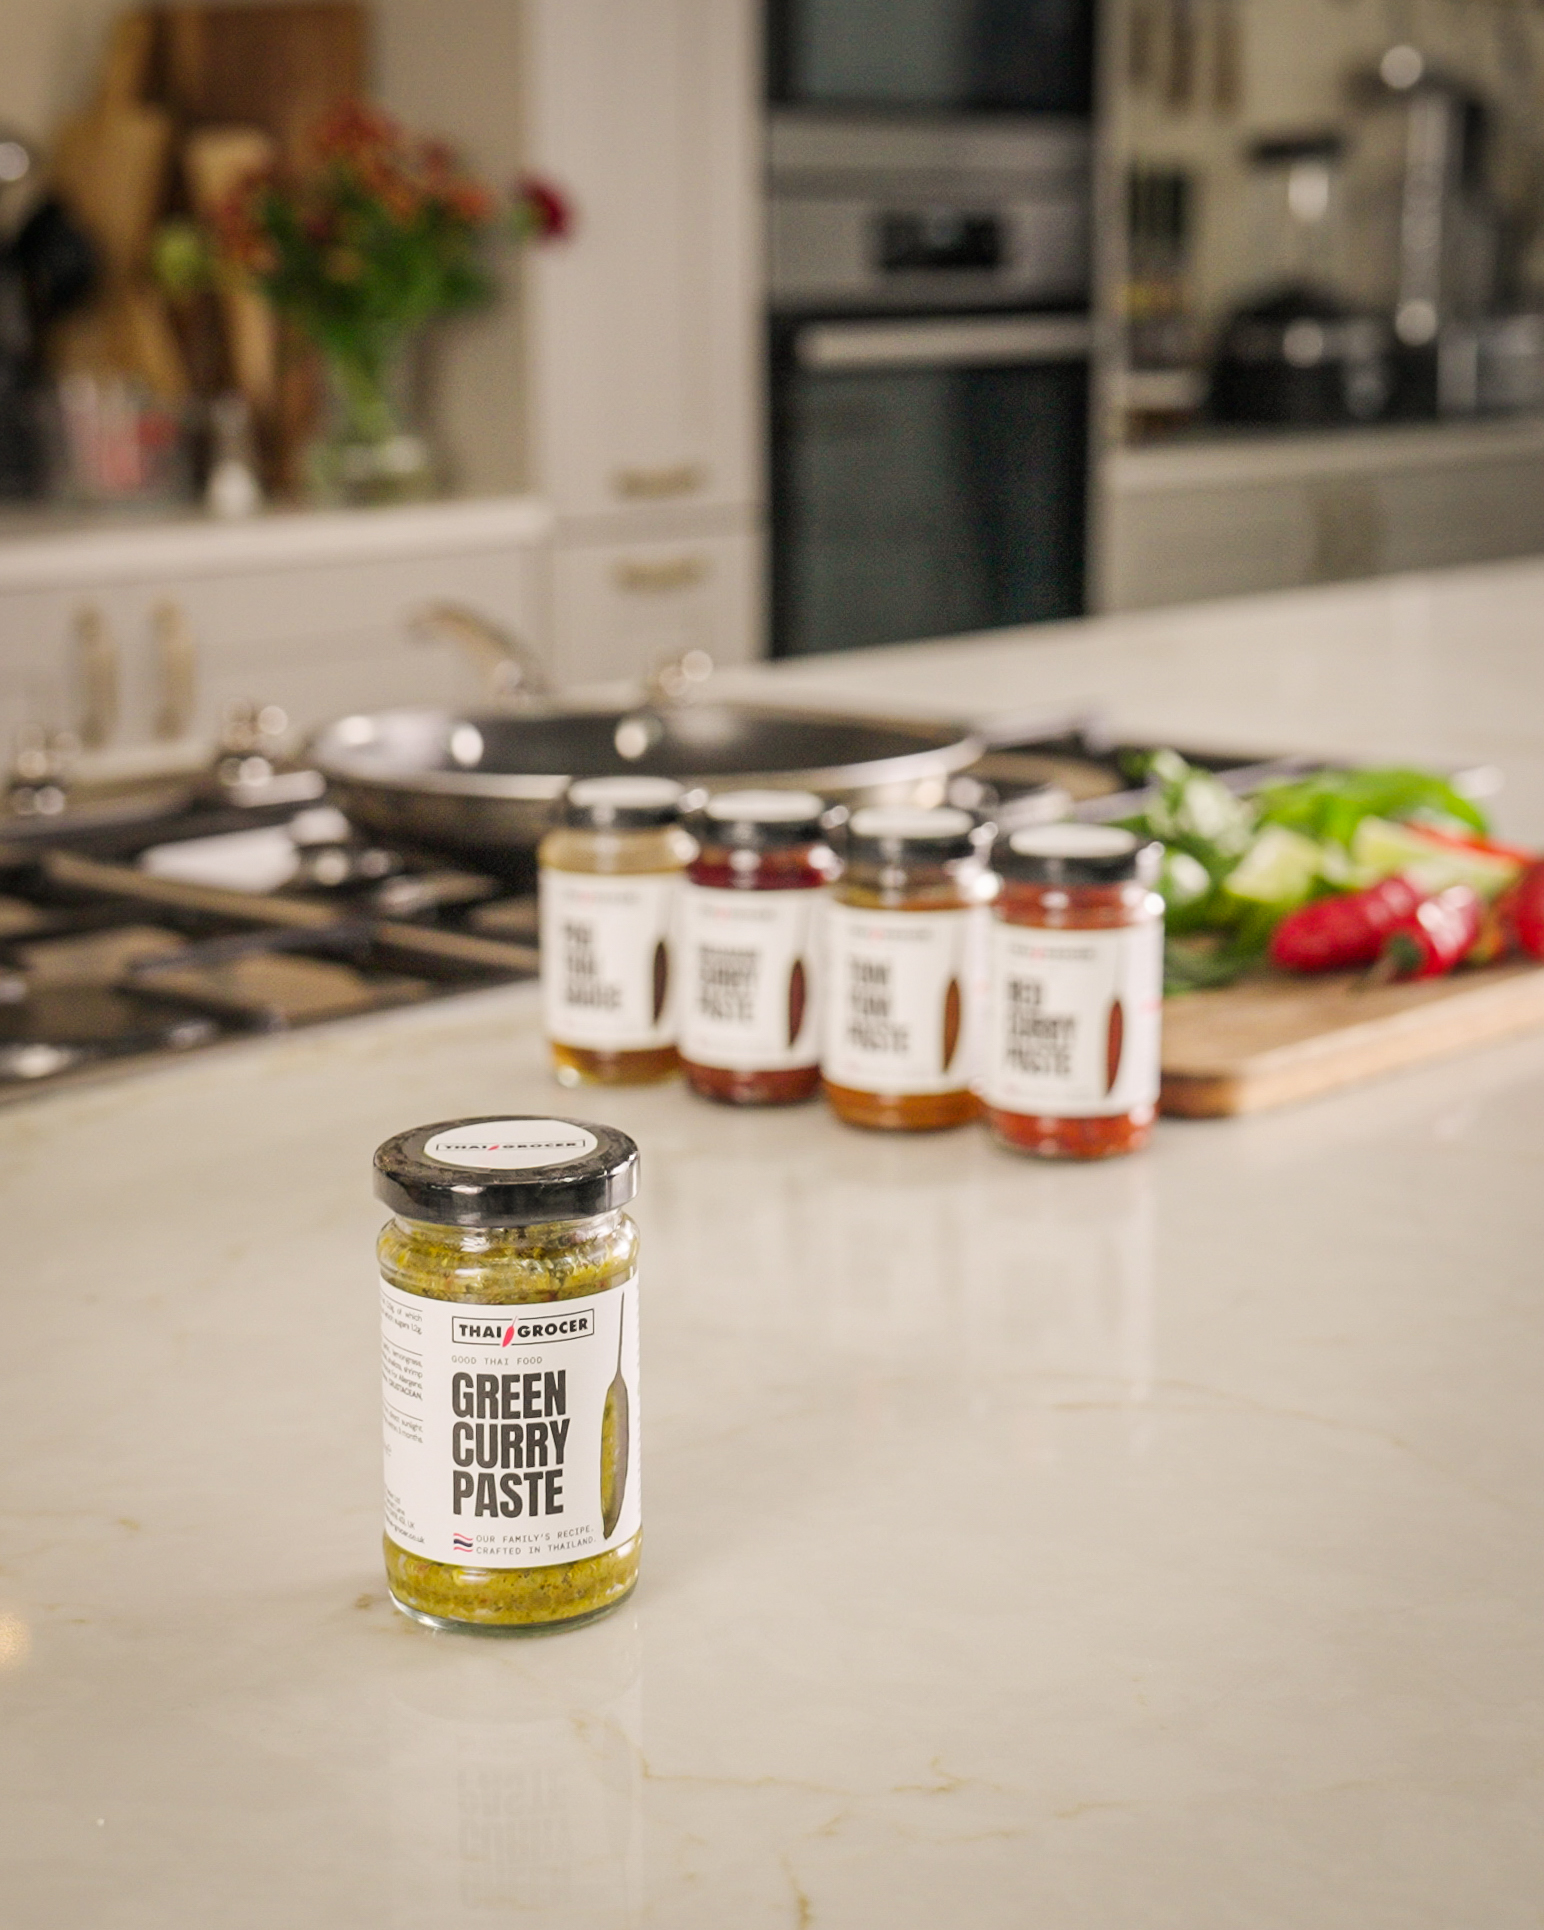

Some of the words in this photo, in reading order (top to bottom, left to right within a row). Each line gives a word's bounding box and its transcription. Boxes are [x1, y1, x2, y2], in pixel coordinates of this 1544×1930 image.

[502, 1142, 578, 1150] GROCER
[459, 1324, 501, 1338] THAI
[517, 1318, 588, 1338] GROCER
[452, 1355, 477, 1365] GOOD
[484, 1357, 509, 1366] THAI
[517, 1356, 543, 1365] FOOD
[452, 1370, 566, 1420] GREEN
[452, 1418, 571, 1469] CURRY
[453, 1468, 564, 1518] PASTE
[476, 1534, 496, 1543] OUR
[503, 1533, 551, 1543] FAMILY'S
[557, 1524, 595, 1539] RECIPE.
[476, 1546, 522, 1555] CRAFTED
[548, 1537, 597, 1552] THAILAND.
